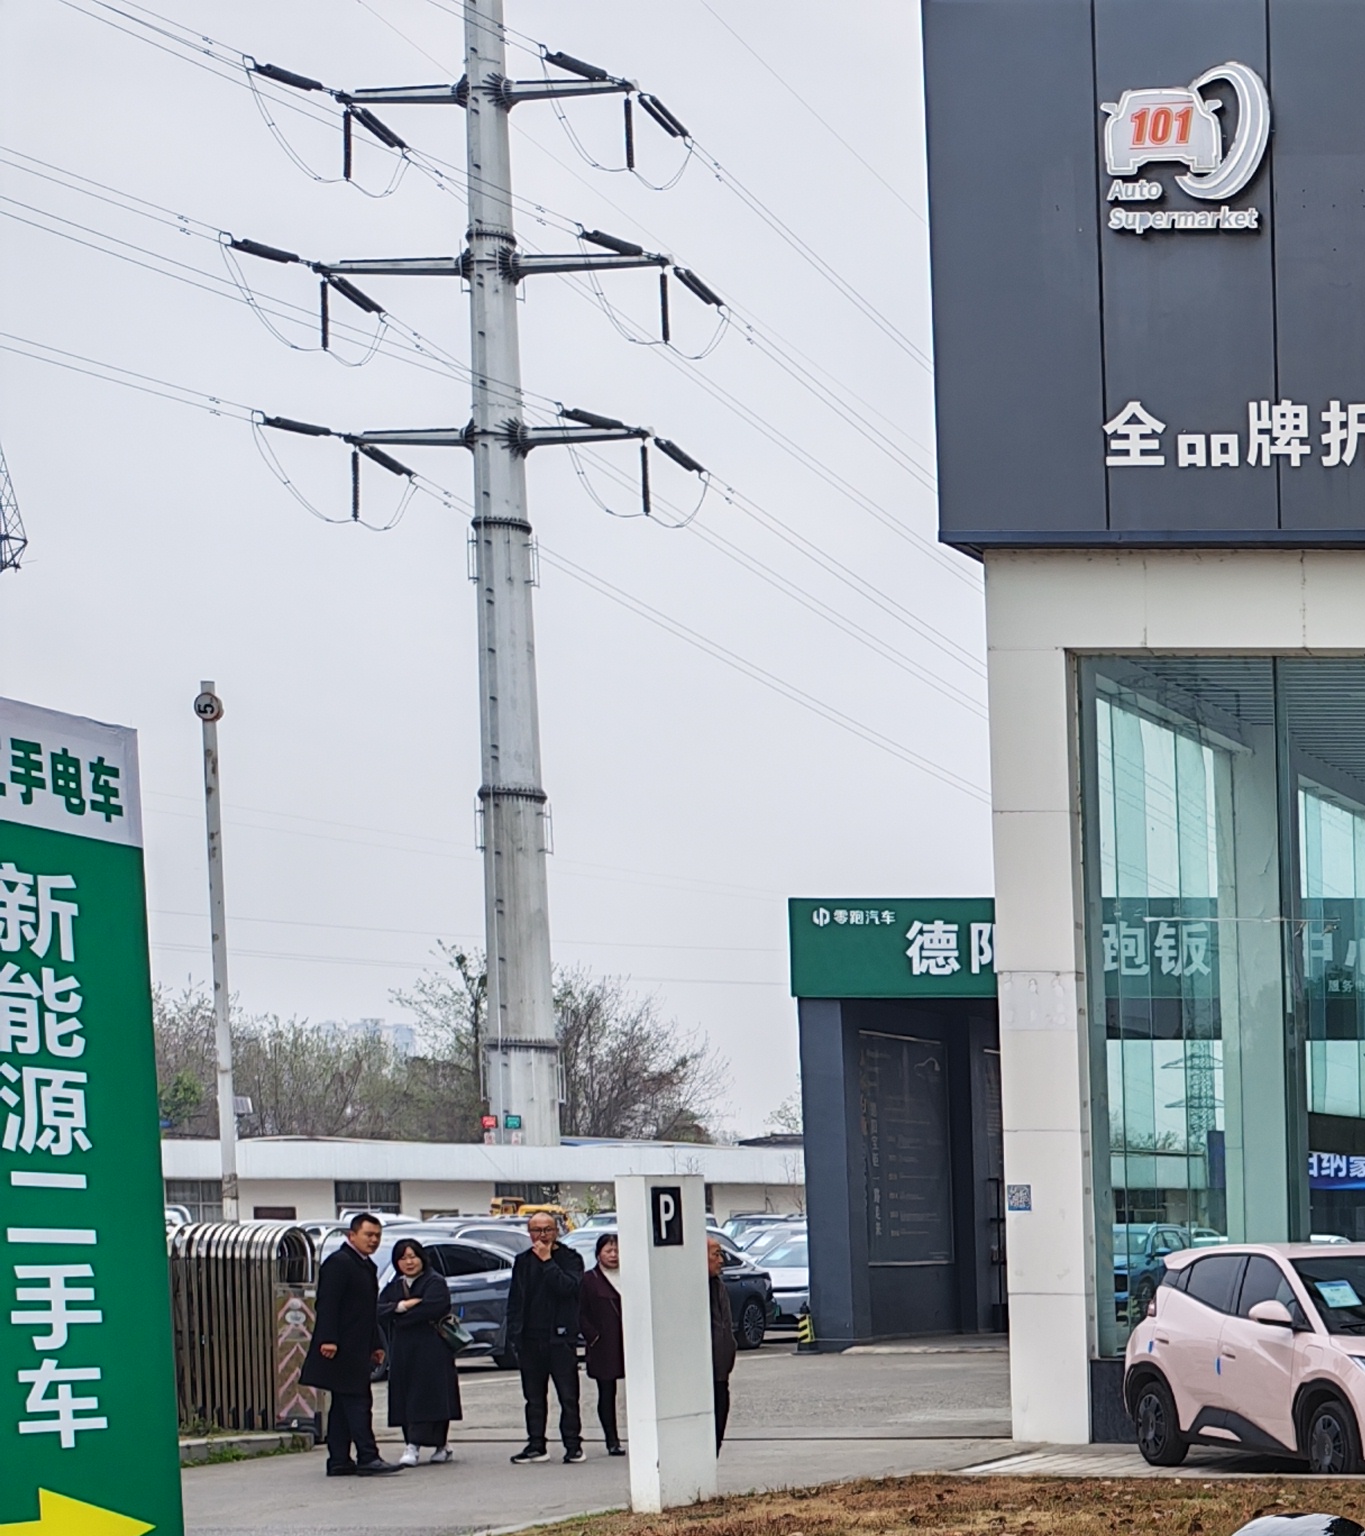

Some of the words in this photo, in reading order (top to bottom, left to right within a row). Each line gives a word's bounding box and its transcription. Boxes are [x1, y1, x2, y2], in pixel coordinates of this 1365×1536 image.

[1131, 107, 1194, 146] 101
[1107, 179, 1163, 201] Auto
[1108, 205, 1259, 234] Supermarket
[0, 736, 124, 824] 手电车
[833, 909, 897, 925] 零跑汽车
[0, 863, 109, 1449] 新能源二手车
[658, 1194, 676, 1241] P
